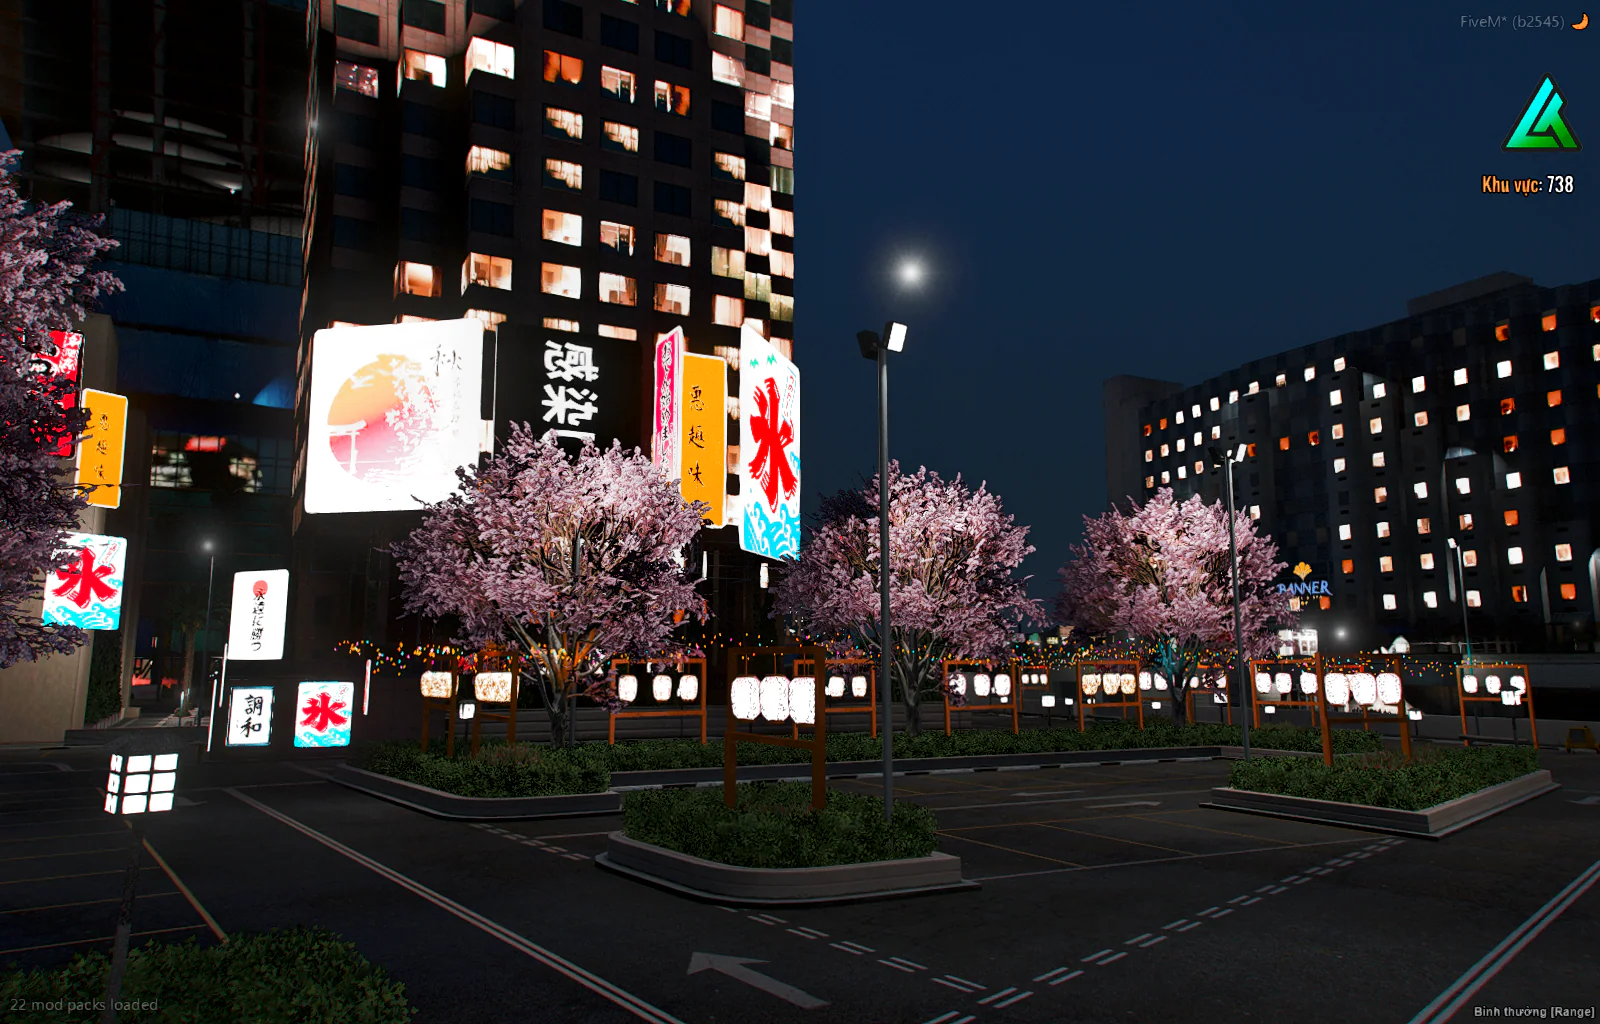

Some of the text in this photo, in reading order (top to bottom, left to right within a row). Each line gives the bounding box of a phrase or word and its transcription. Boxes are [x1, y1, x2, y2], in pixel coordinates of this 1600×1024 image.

[748, 377, 798, 513] 氷
[51, 547, 118, 609] 氷
[1276, 580, 1334, 597] BANNER
[240, 694, 264, 738] 調和
[300, 692, 348, 733] 氷
